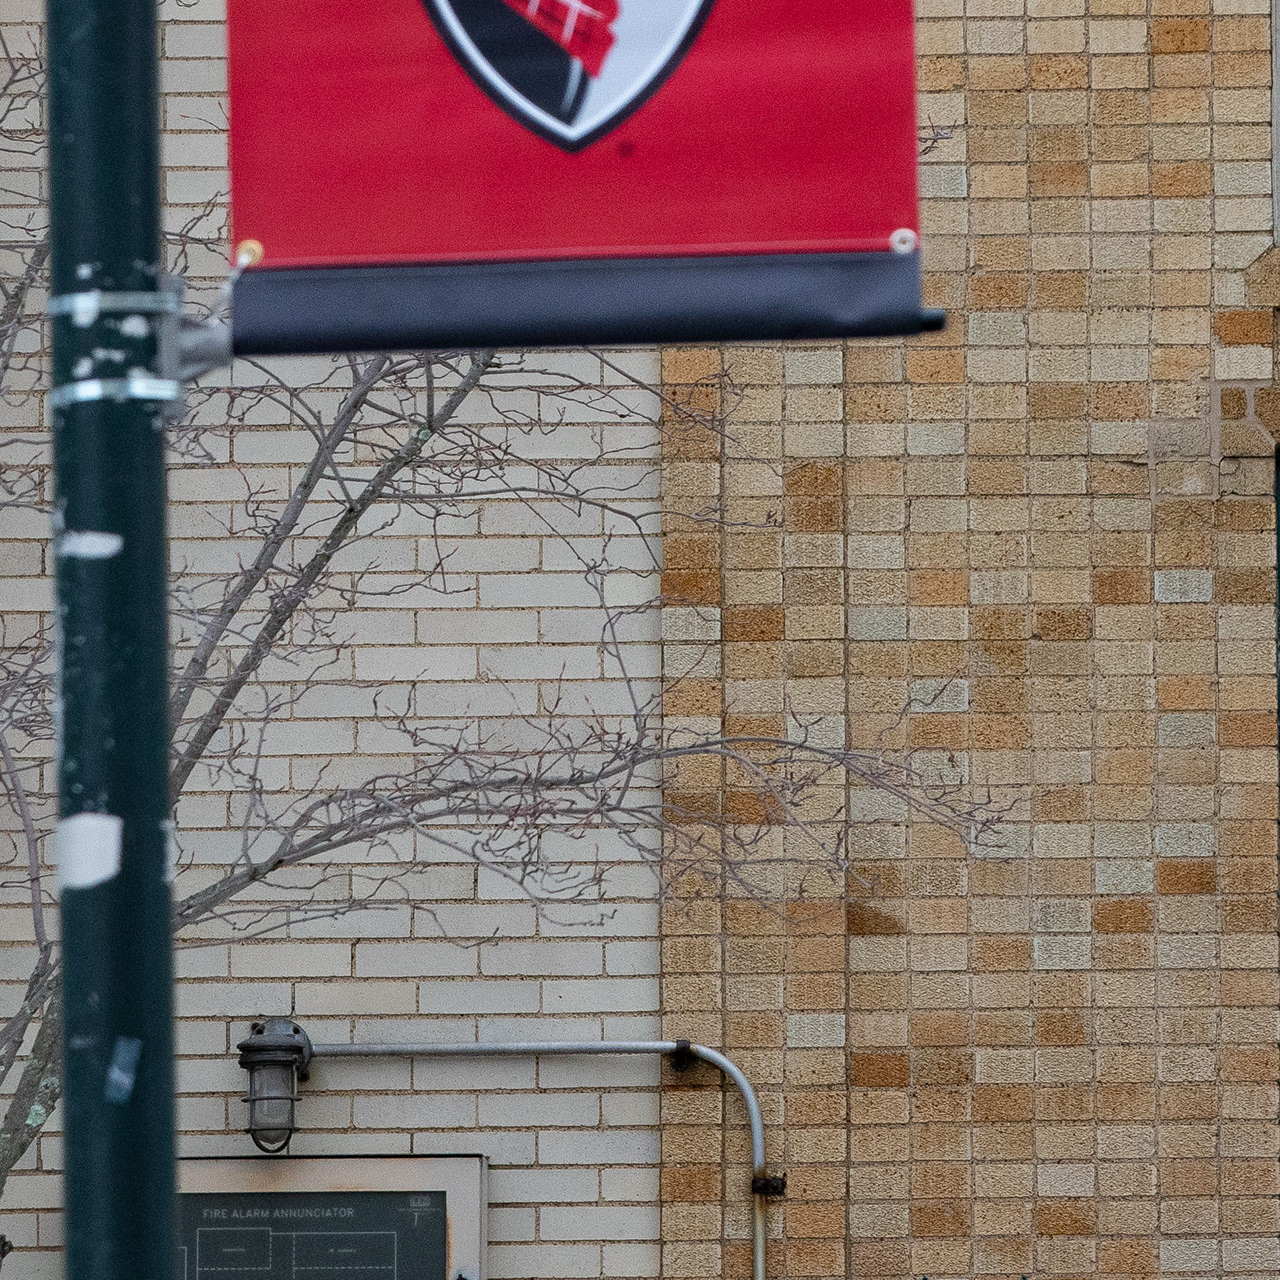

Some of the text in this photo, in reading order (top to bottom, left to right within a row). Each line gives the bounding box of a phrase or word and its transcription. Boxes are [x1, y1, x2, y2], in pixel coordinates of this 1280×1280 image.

[203, 1207, 355, 1219] FIRE ALARM ANNUNCIATOR
